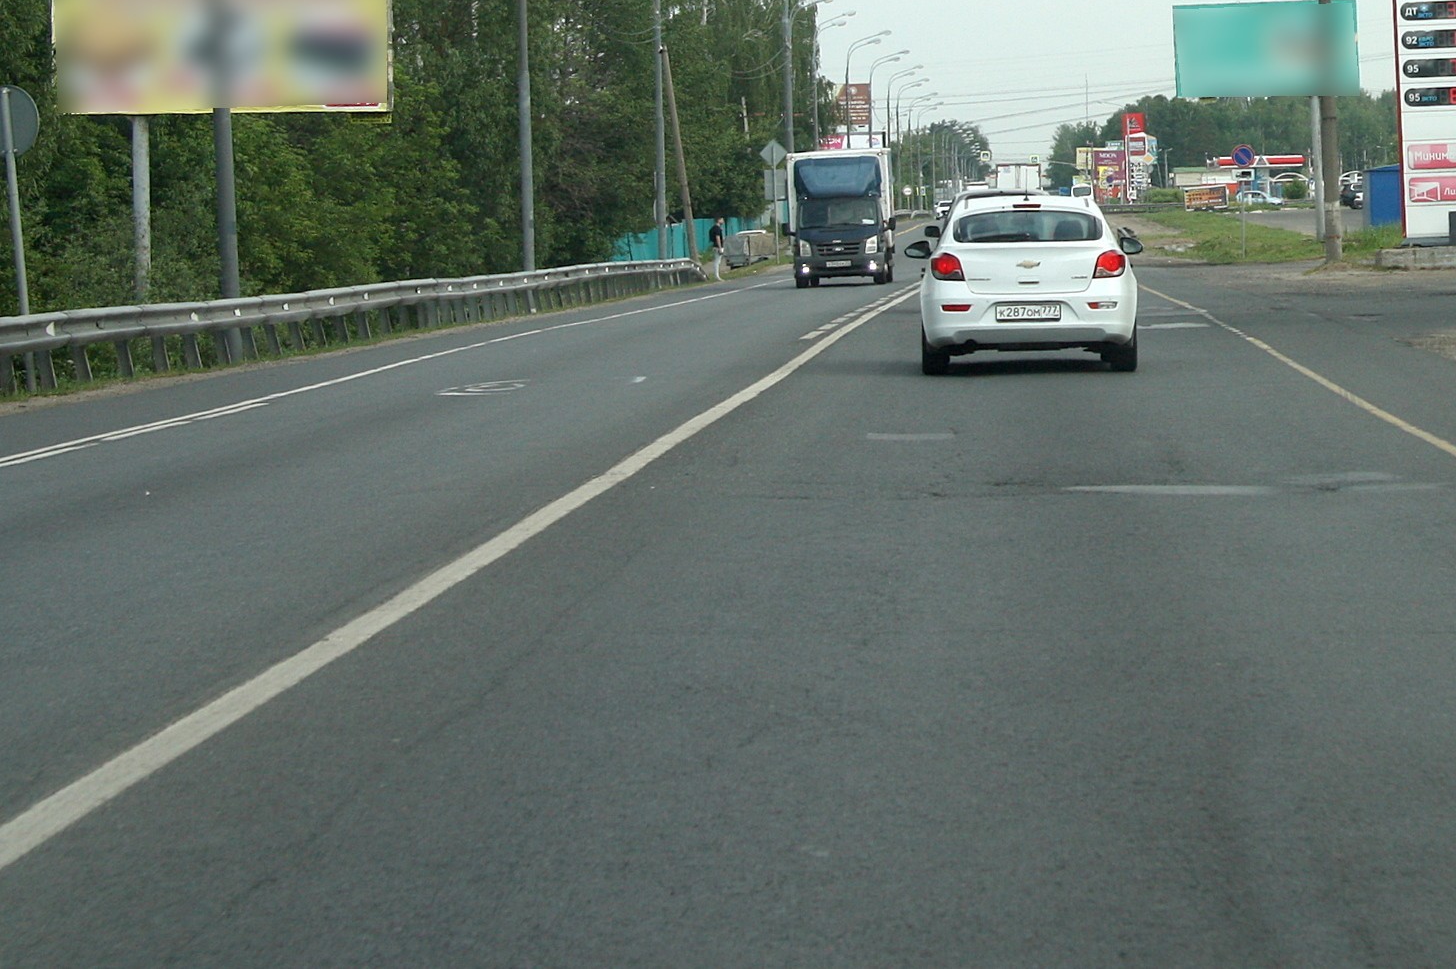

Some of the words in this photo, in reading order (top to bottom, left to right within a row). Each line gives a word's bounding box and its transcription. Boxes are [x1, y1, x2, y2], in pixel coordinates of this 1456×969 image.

[1405, 7, 1418, 17] ДТ
[1405, 36, 1417, 44] 92
[1407, 64, 1419, 73] 95
[1408, 93, 1420, 102] 95
